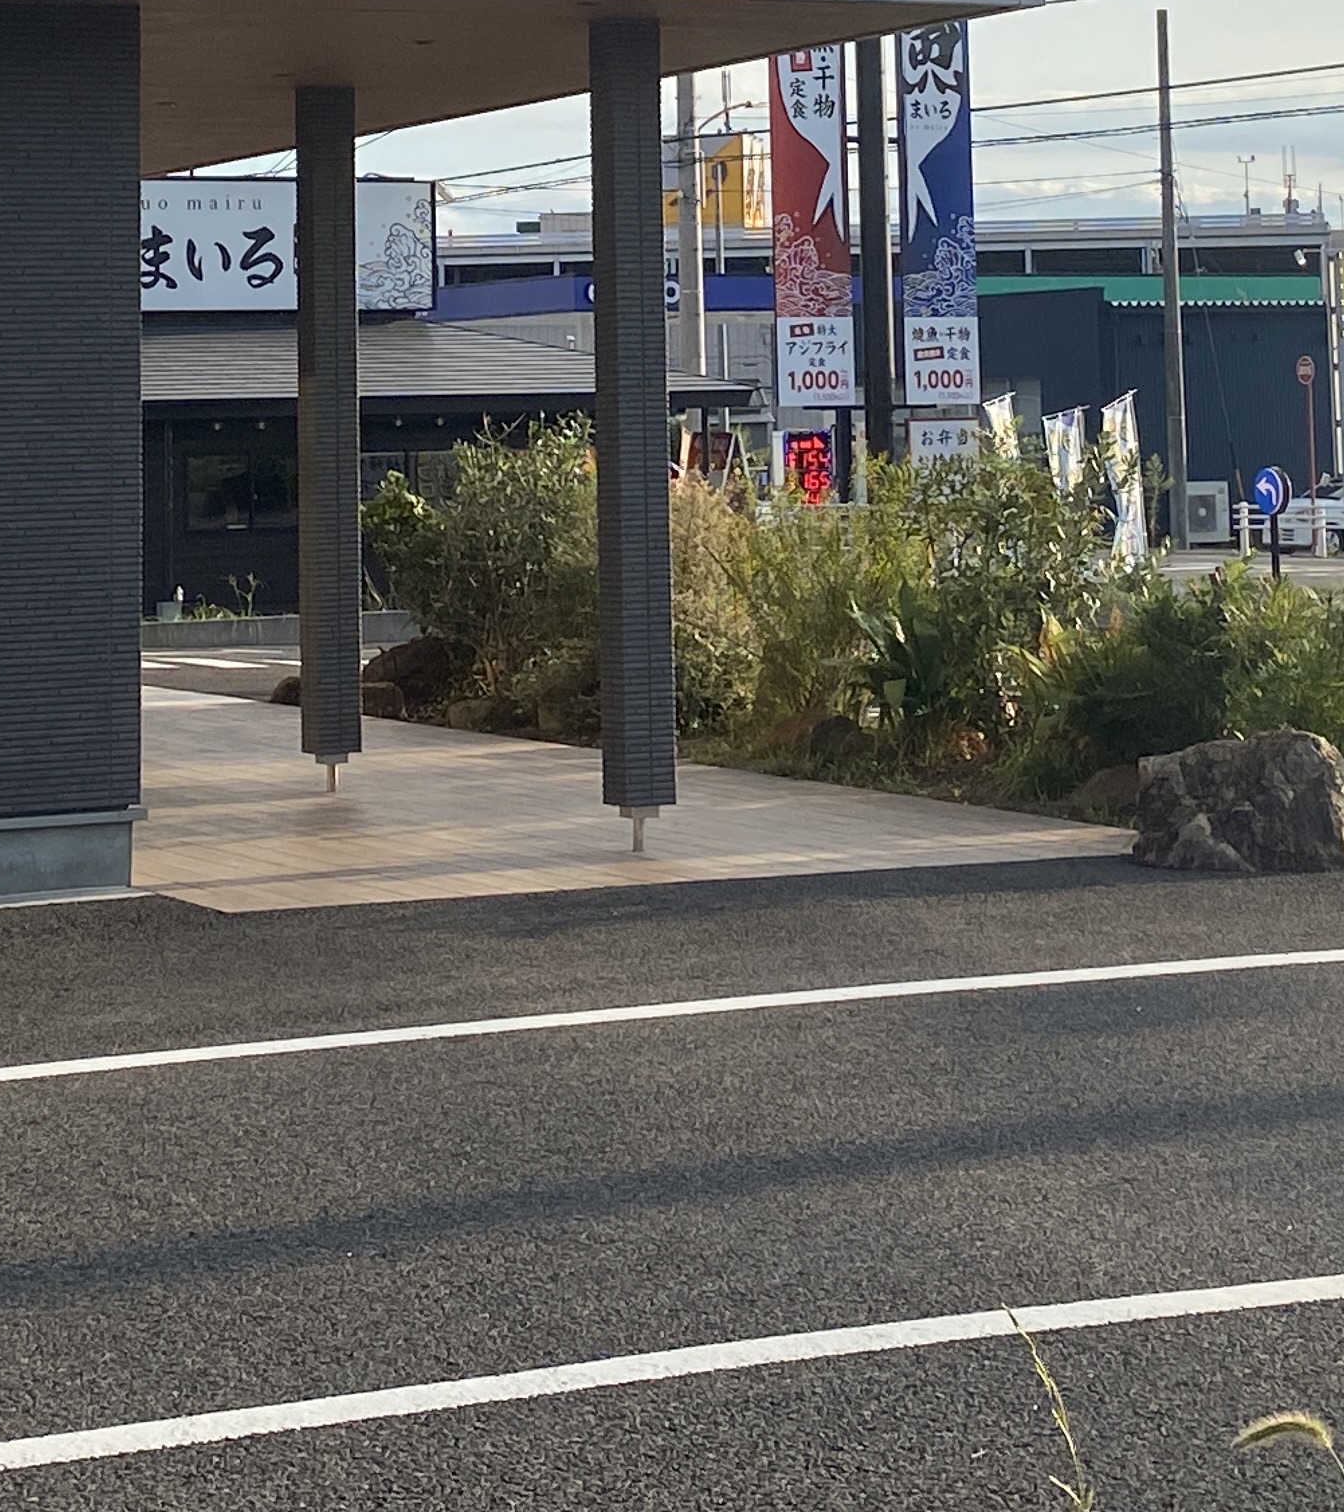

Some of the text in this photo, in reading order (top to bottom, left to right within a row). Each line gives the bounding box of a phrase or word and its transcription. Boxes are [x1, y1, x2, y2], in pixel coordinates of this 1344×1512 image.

[789, 77, 808, 120] 定食
[910, 99, 952, 121] まいる
[186, 194, 263, 211] mairu
[785, 339, 849, 356] アジフライ
[804, 471, 831, 489] 165
